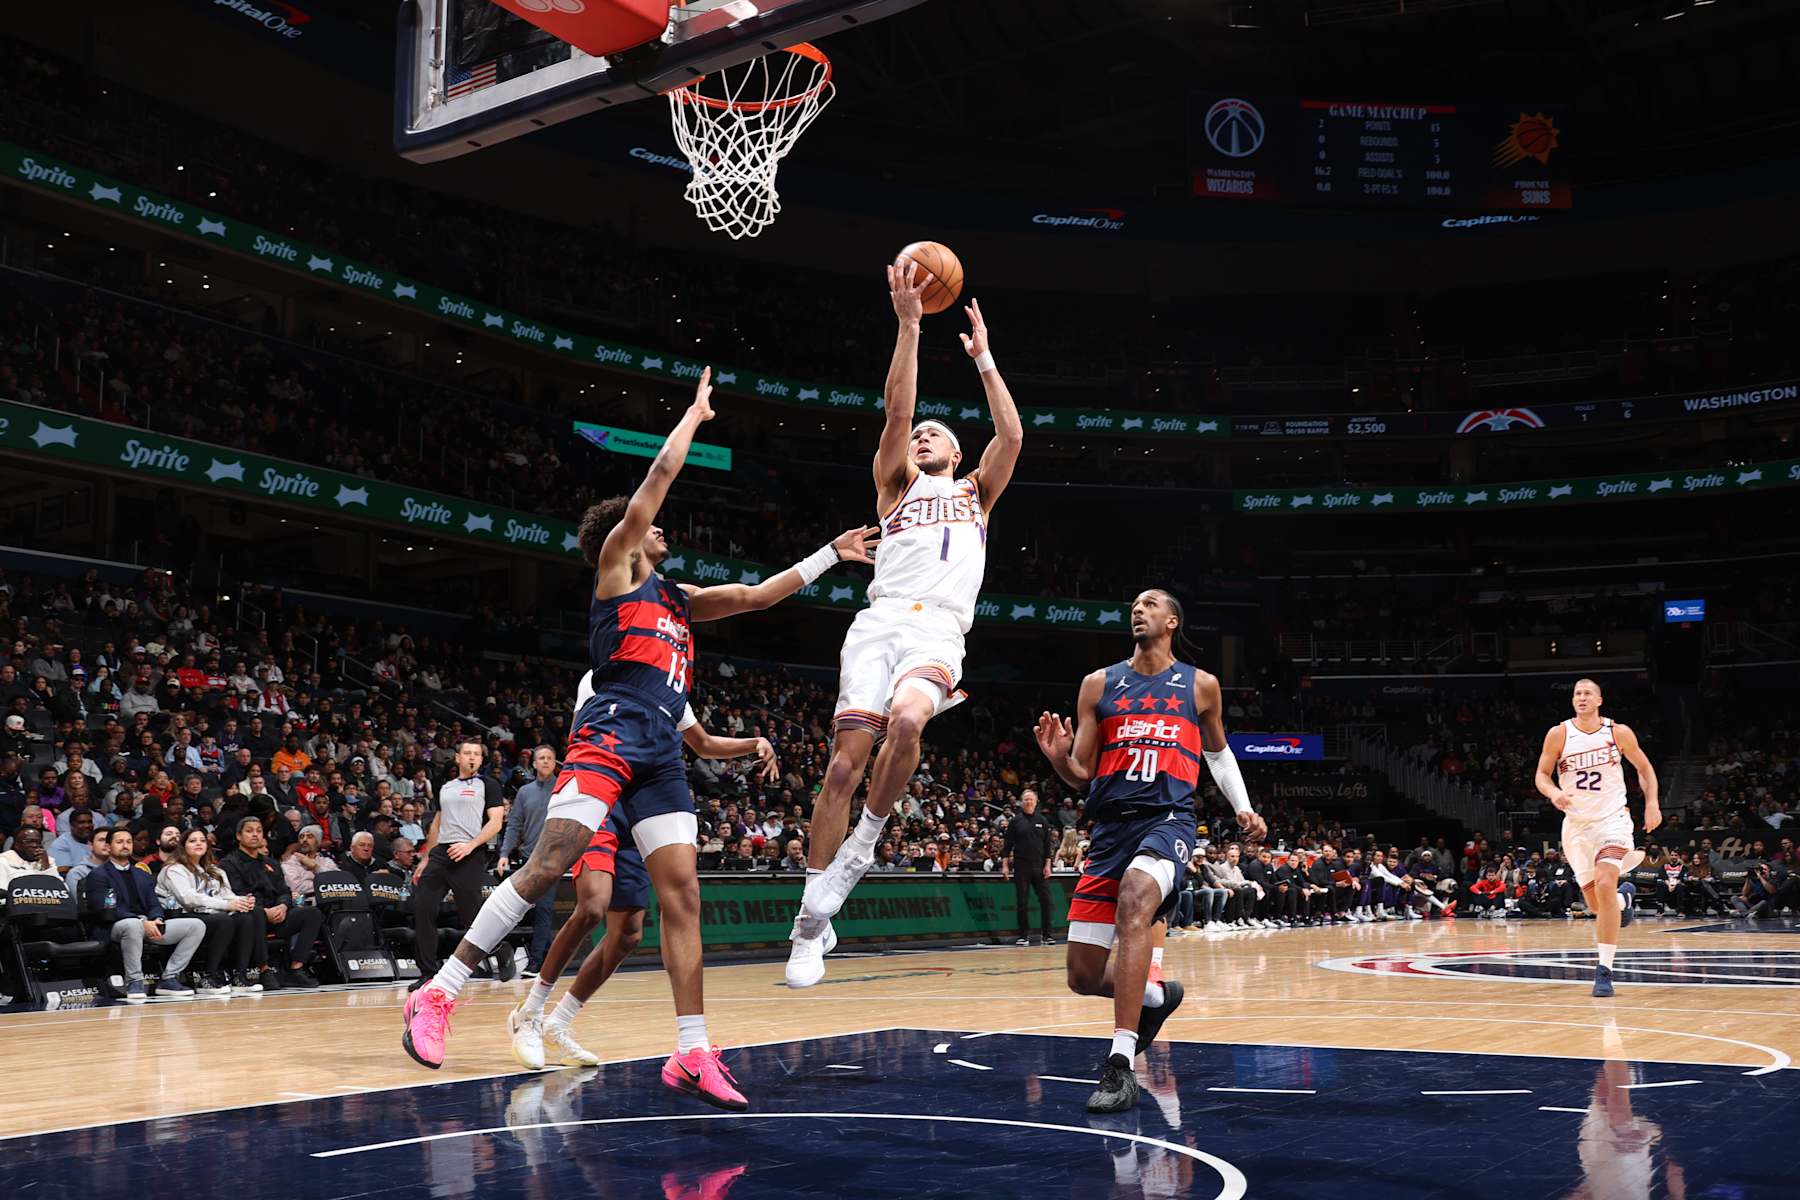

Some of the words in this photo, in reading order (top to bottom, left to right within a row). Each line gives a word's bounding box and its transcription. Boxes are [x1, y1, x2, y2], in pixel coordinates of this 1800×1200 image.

[1329, 104, 1364, 118] GAME
[19, 158, 75, 189] Sprite
[1207, 178, 1254, 194] WIZARDS
[1520, 190, 1551, 205] SUNS
[134, 196, 185, 224] Sprite
[253, 235, 298, 261] Sprite
[342, 265, 382, 289] Sprite
[438, 297, 475, 319] Sprite
[512, 321, 545, 342] Sprite
[595, 346, 632, 364] Sprite
[755, 379, 789, 396] Sprite
[828, 391, 864, 405] Sprite
[1683, 386, 1797, 411] WASHINGTON
[916, 401, 951, 416] Sprite
[1624, 409, 1632, 419] 6
[1076, 415, 1112, 428] Sprite
[1151, 418, 1187, 432] Sprite
[1347, 423, 1386, 434] $2,500
[120, 439, 190, 472] Sprite
[259, 467, 319, 497] Sprite
[1596, 480, 1638, 497] Sprite
[1682, 473, 1725, 491] Sprite
[1242, 495, 1281, 510] Sprite
[1322, 493, 1361, 508] Sprite
[1416, 492, 1455, 506] Sprite
[1497, 488, 1537, 504] Sprite
[400, 497, 452, 525] Sprite
[503, 518, 549, 545] Sprite
[939, 526, 950, 561] 1
[693, 559, 731, 582] Sprite
[1045, 606, 1087, 624] Sprite
[666, 652, 688, 694] 13
[1117, 717, 1181, 739] district
[1125, 747, 1159, 783] 20
[1576, 770, 1602, 791] 22
[1273, 782, 1334, 800] Hennessy
[1336, 782, 1368, 799] Lofts
[12, 888, 69, 899] CAESARS
[319, 883, 363, 892] CAESARS
[13, 897, 62, 905] SPORTSBOOK
[60, 986, 99, 998] CAESARS
